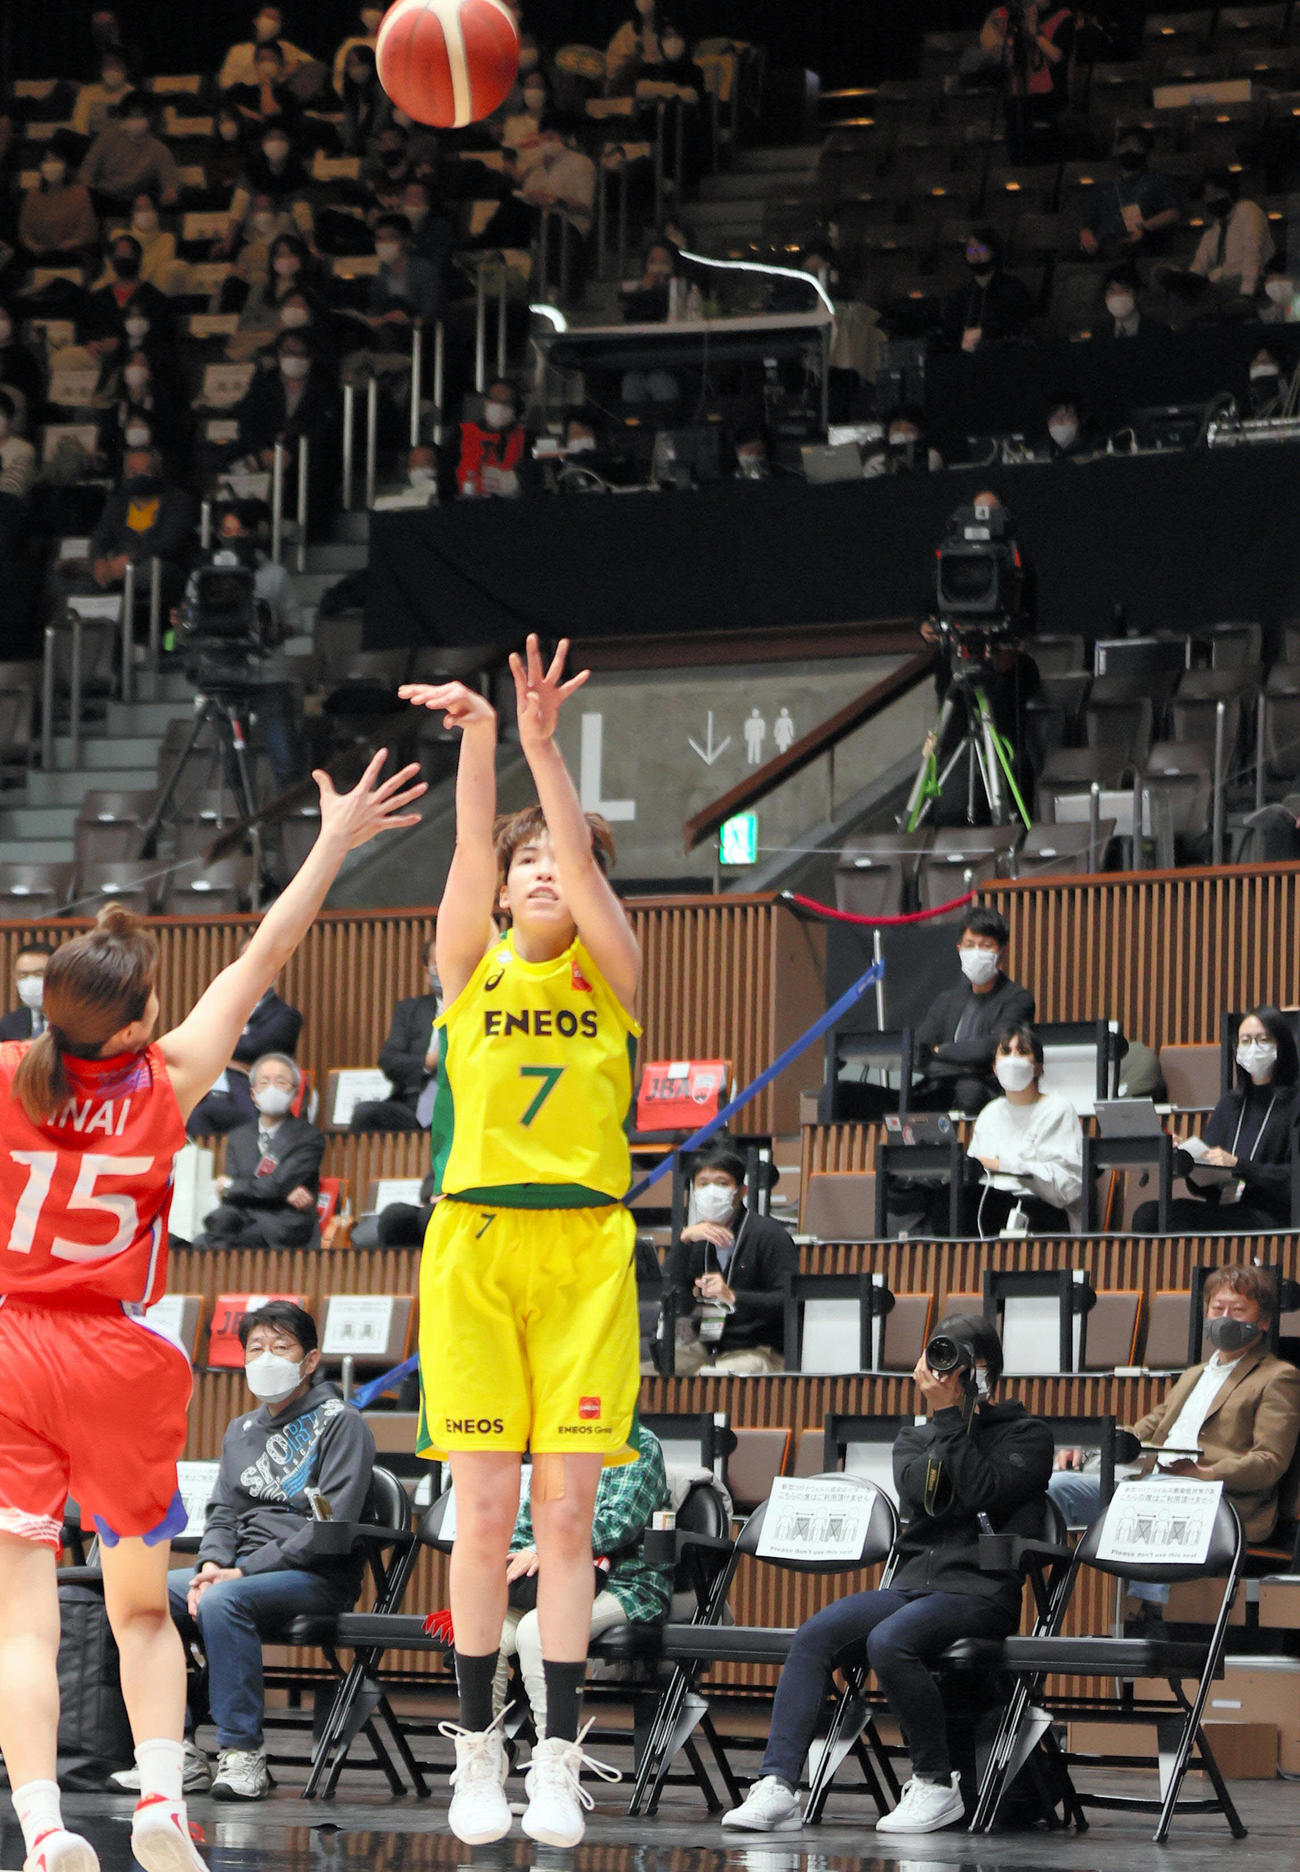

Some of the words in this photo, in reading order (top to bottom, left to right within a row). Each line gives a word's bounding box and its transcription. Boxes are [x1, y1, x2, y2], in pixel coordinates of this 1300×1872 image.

[581, 713, 635, 821] L
[485, 1010, 598, 1038] ENEOS
[518, 1064, 568, 1129] 7
[645, 1078, 691, 1101] JBA
[7, 1150, 155, 1264] 15
[475, 1213, 497, 1240] 7
[446, 1418, 504, 1434] ENEOS
[558, 1426, 593, 1434] ENEOS
